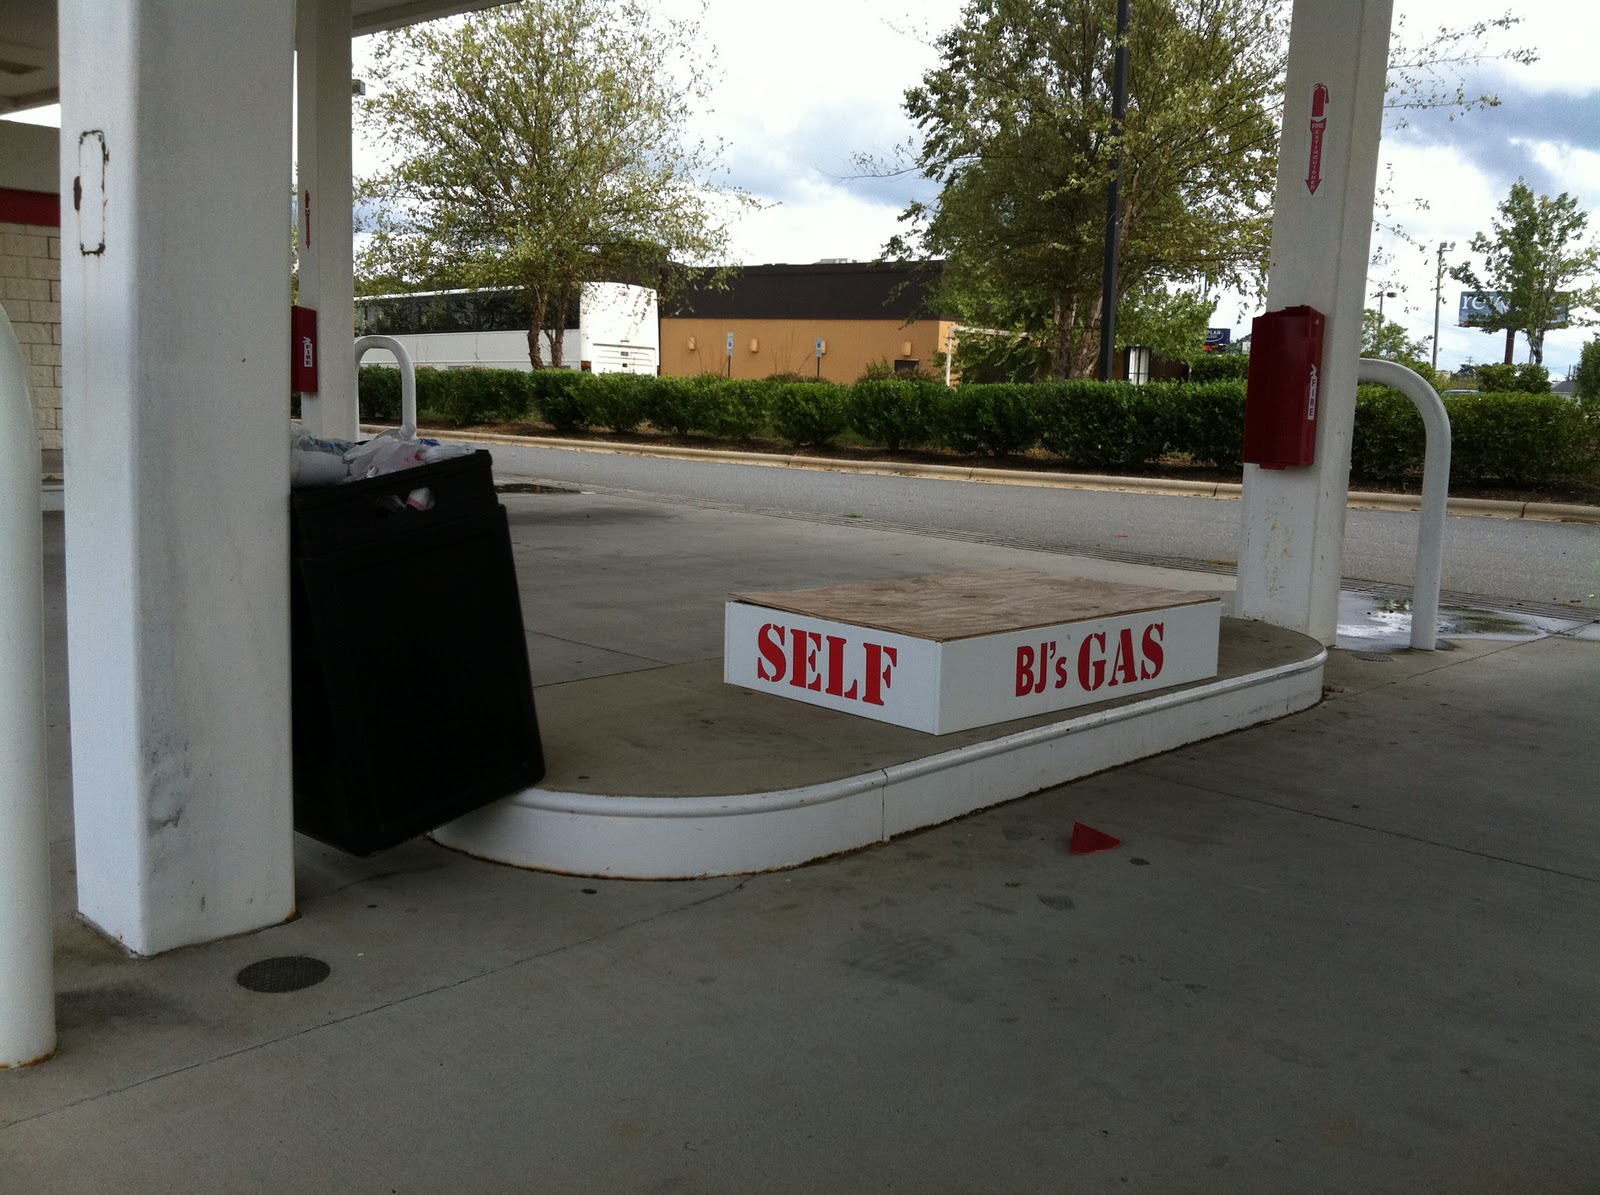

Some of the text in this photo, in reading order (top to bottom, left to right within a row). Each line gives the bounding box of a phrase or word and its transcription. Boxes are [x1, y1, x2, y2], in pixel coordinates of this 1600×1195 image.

[1310, 130, 1319, 190] EXTINGUISHER
[1309, 379, 1317, 416] FIRE
[758, 623, 897, 705] SELF
[1016, 624, 1164, 696] BJ's GAS
